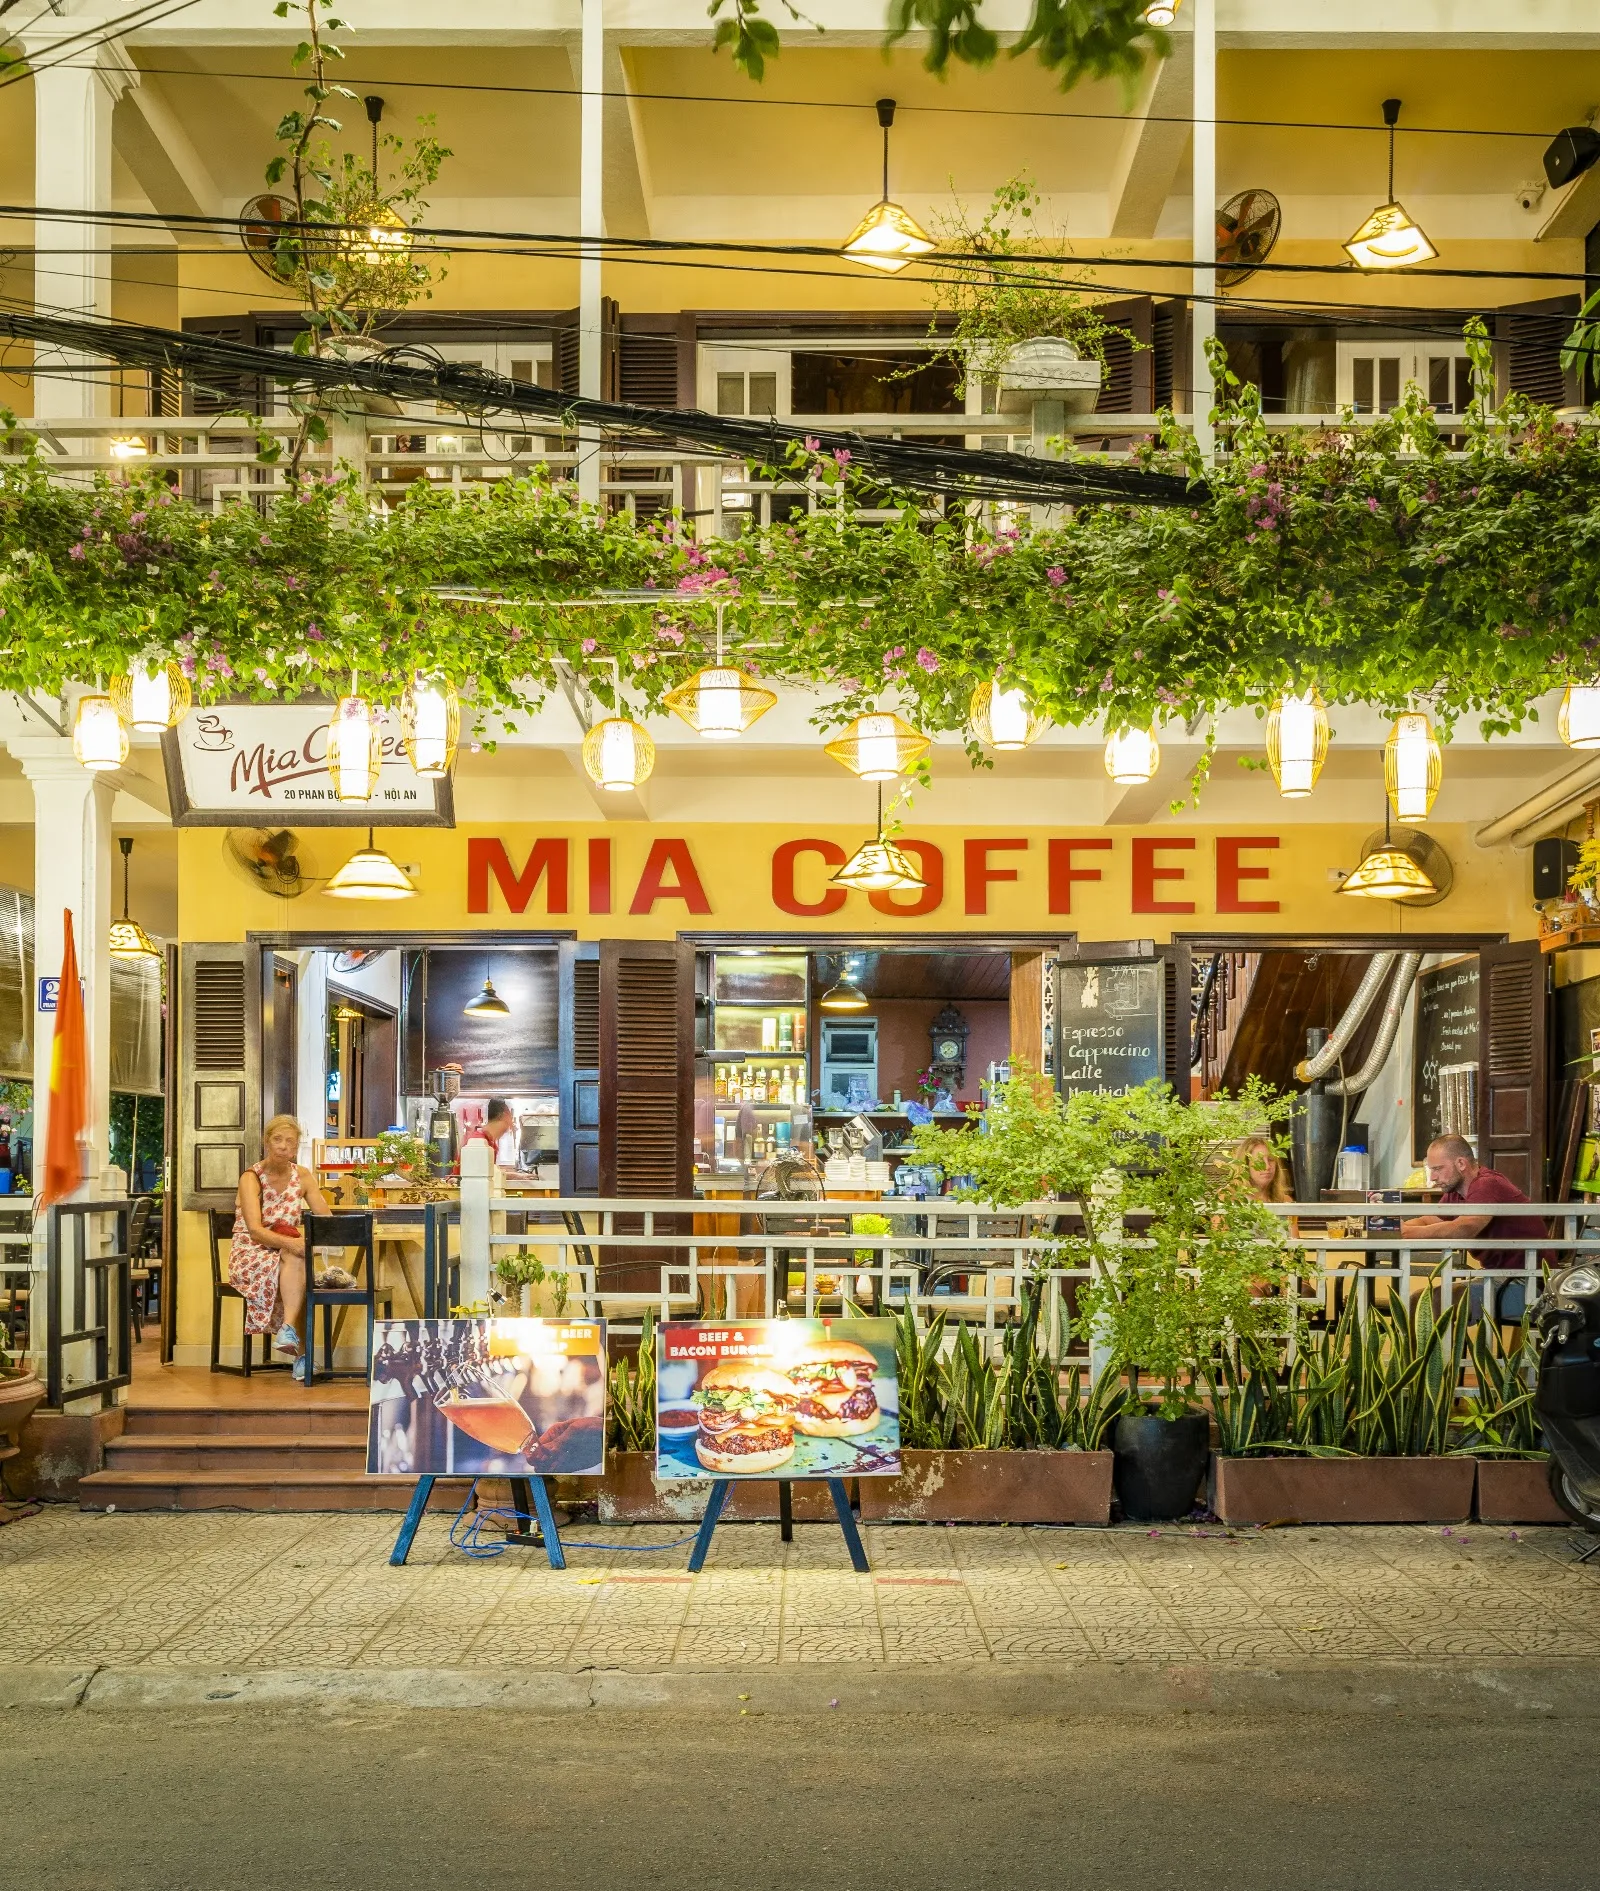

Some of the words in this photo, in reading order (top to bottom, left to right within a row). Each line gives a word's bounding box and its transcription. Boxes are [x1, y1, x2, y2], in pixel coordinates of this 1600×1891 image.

[231, 742, 301, 798] Mia
[302, 719, 408, 763] Cee
[284, 789, 296, 800] 20
[299, 789, 325, 800] PHAN
[384, 787, 401, 802] HỘI
[403, 789, 417, 800] AN
[467, 837, 713, 915] MIA
[771, 836, 1280, 916] COFFEE
[45, 980, 61, 1001] 2
[1062, 1026, 1125, 1045] Espresso
[1068, 1043, 1151, 1066] Cappuccino
[1062, 1065, 1103, 1080] Latte
[560, 1328, 593, 1339] BEER
[698, 1332, 729, 1343] BEEF
[733, 1331, 745, 1342] &
[670, 1345, 717, 1357] BACON
